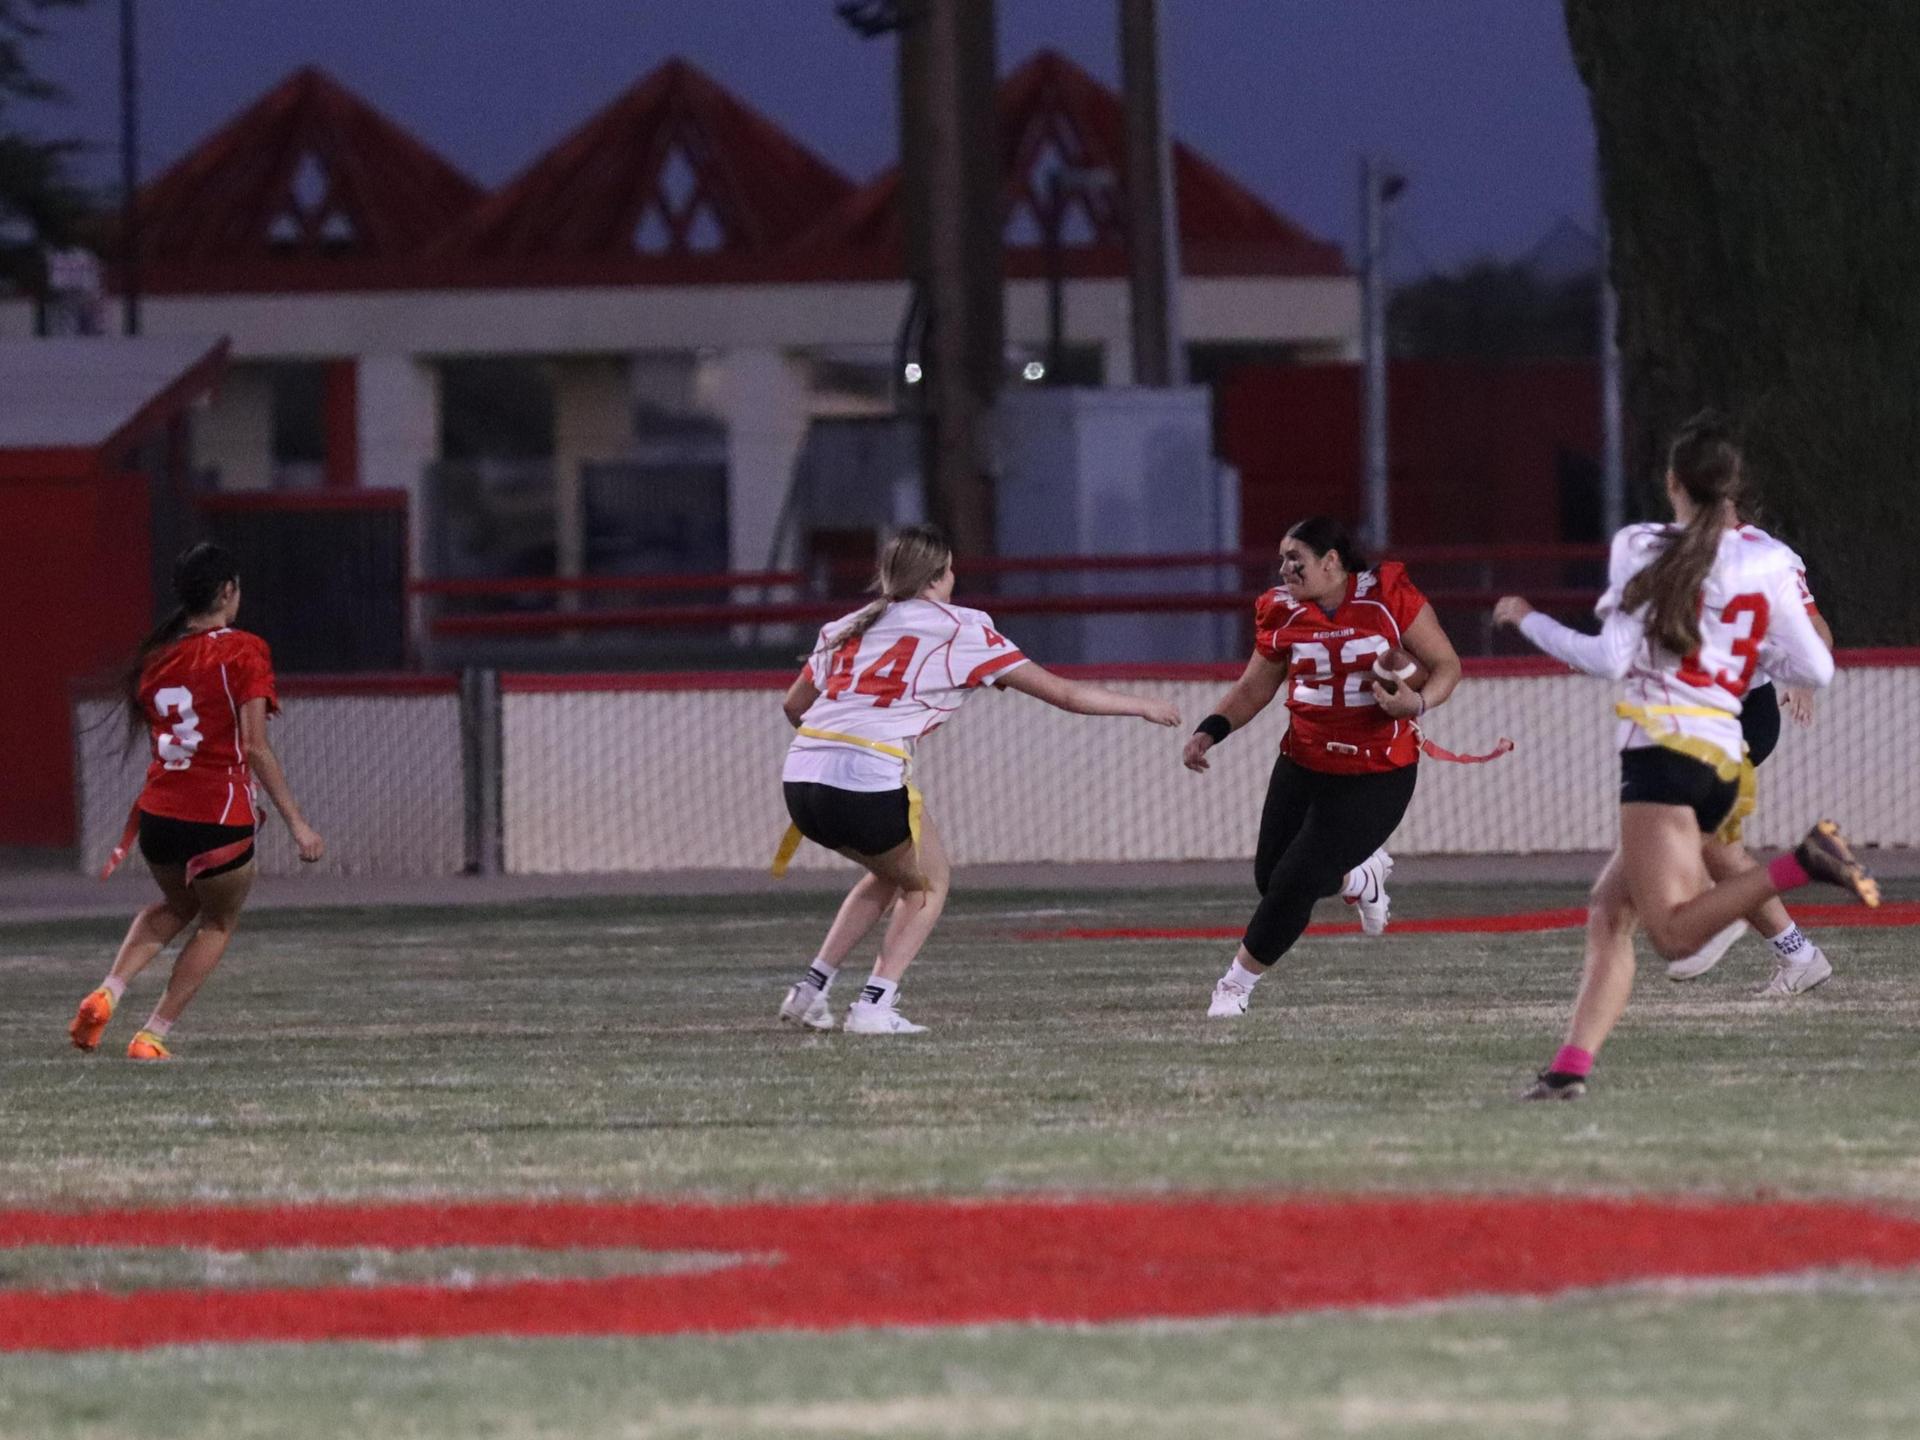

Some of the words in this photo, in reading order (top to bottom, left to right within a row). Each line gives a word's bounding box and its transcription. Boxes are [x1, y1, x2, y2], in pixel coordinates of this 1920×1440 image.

[826, 634, 921, 709] 44
[1290, 634, 1392, 708] 22
[153, 685, 204, 771] 3
